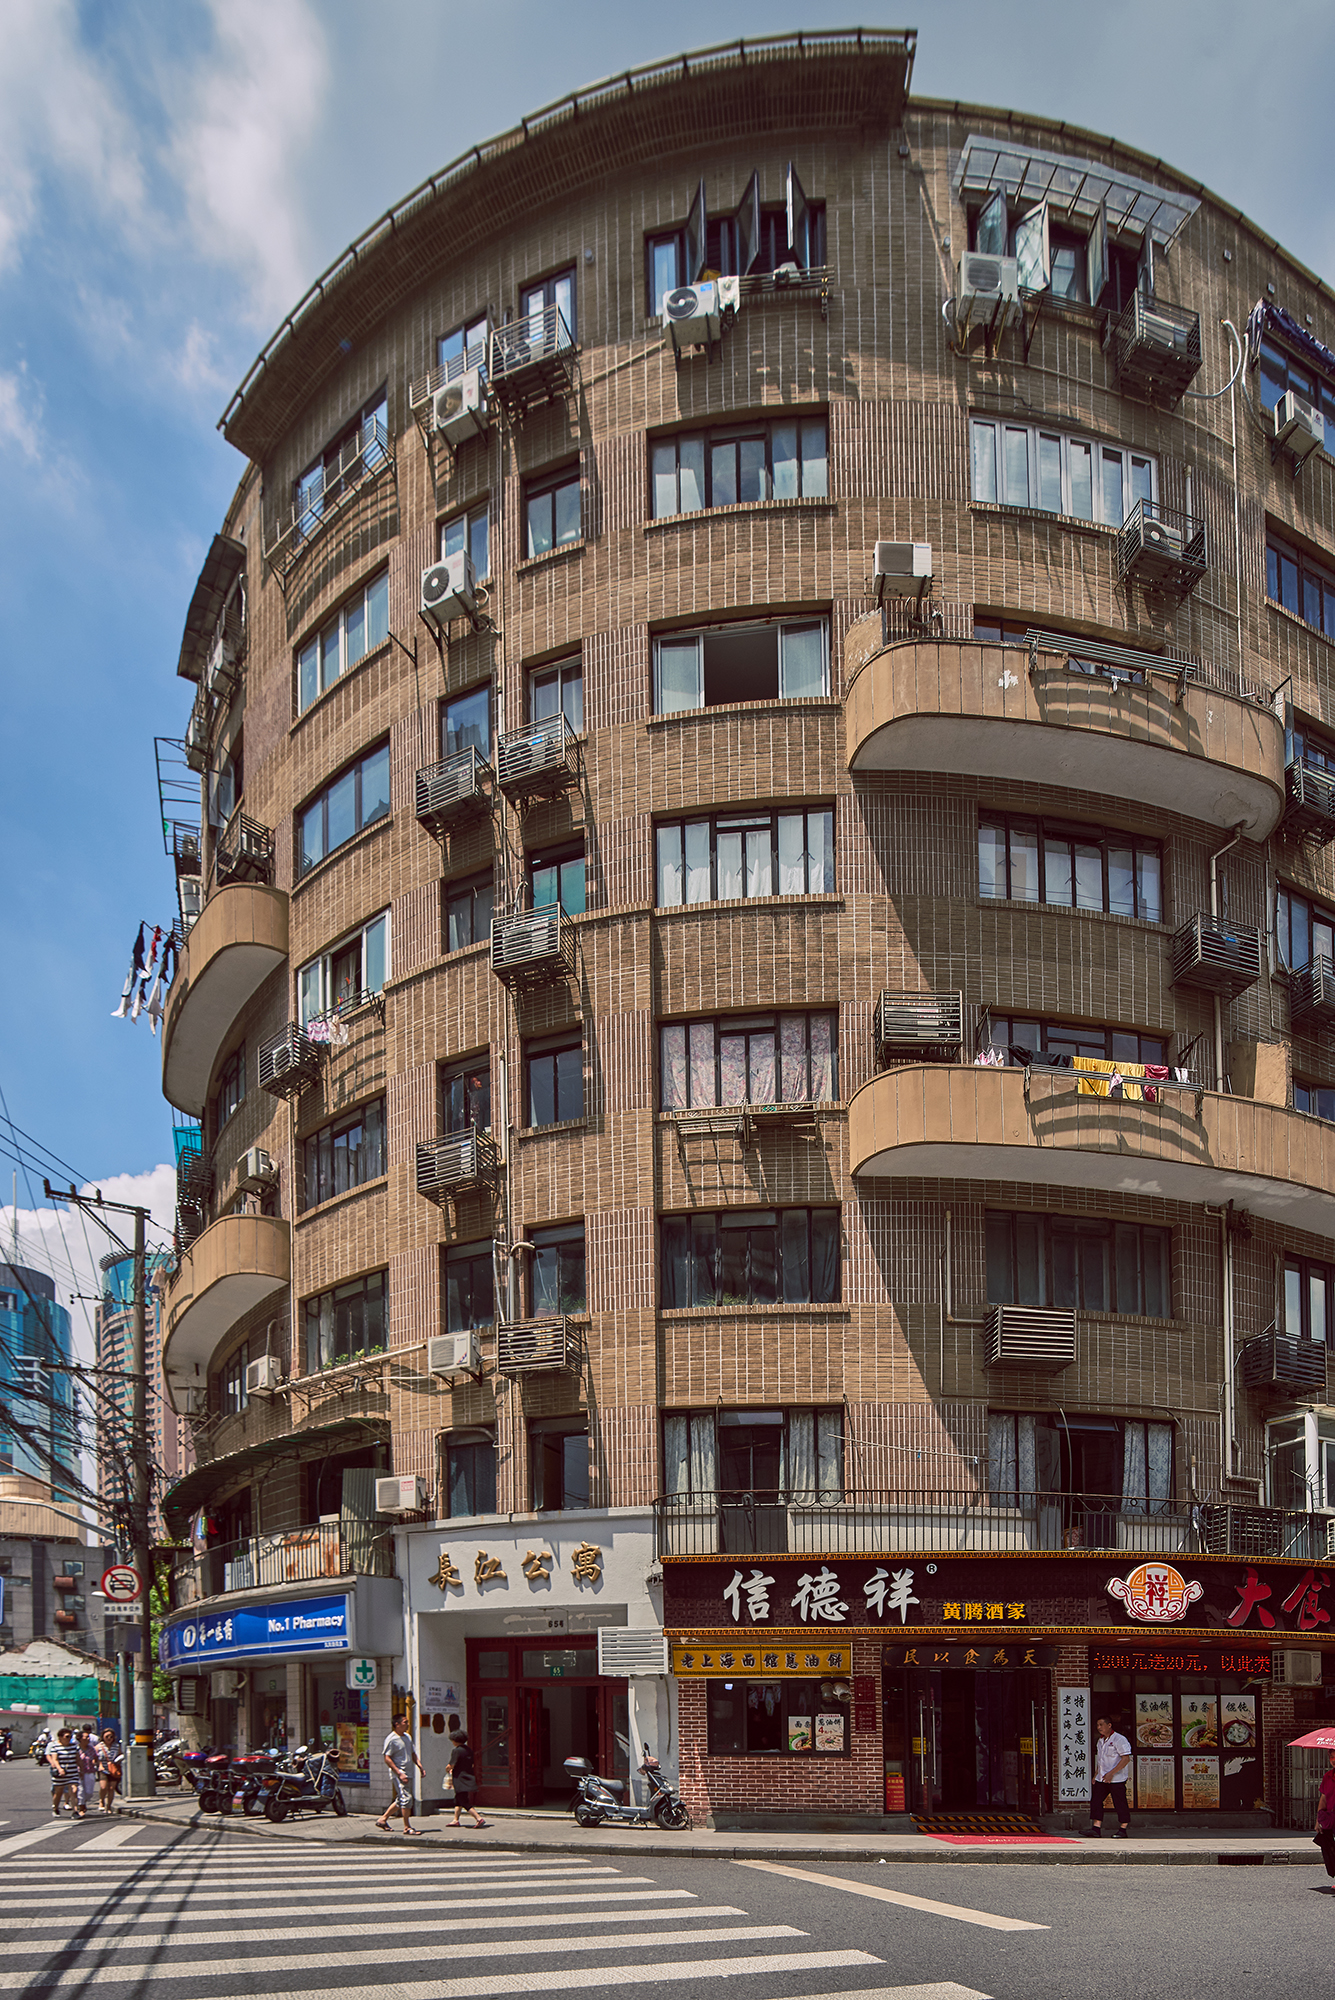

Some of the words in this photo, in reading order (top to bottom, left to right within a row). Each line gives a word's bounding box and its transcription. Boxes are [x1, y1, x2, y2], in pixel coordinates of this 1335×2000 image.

[724, 1566, 920, 1625] 信德祥
[943, 1602, 1026, 1620] 黄腾酒家
[268, 1617, 290, 1632] No.1
[293, 1615, 344, 1630] Pharmacy
